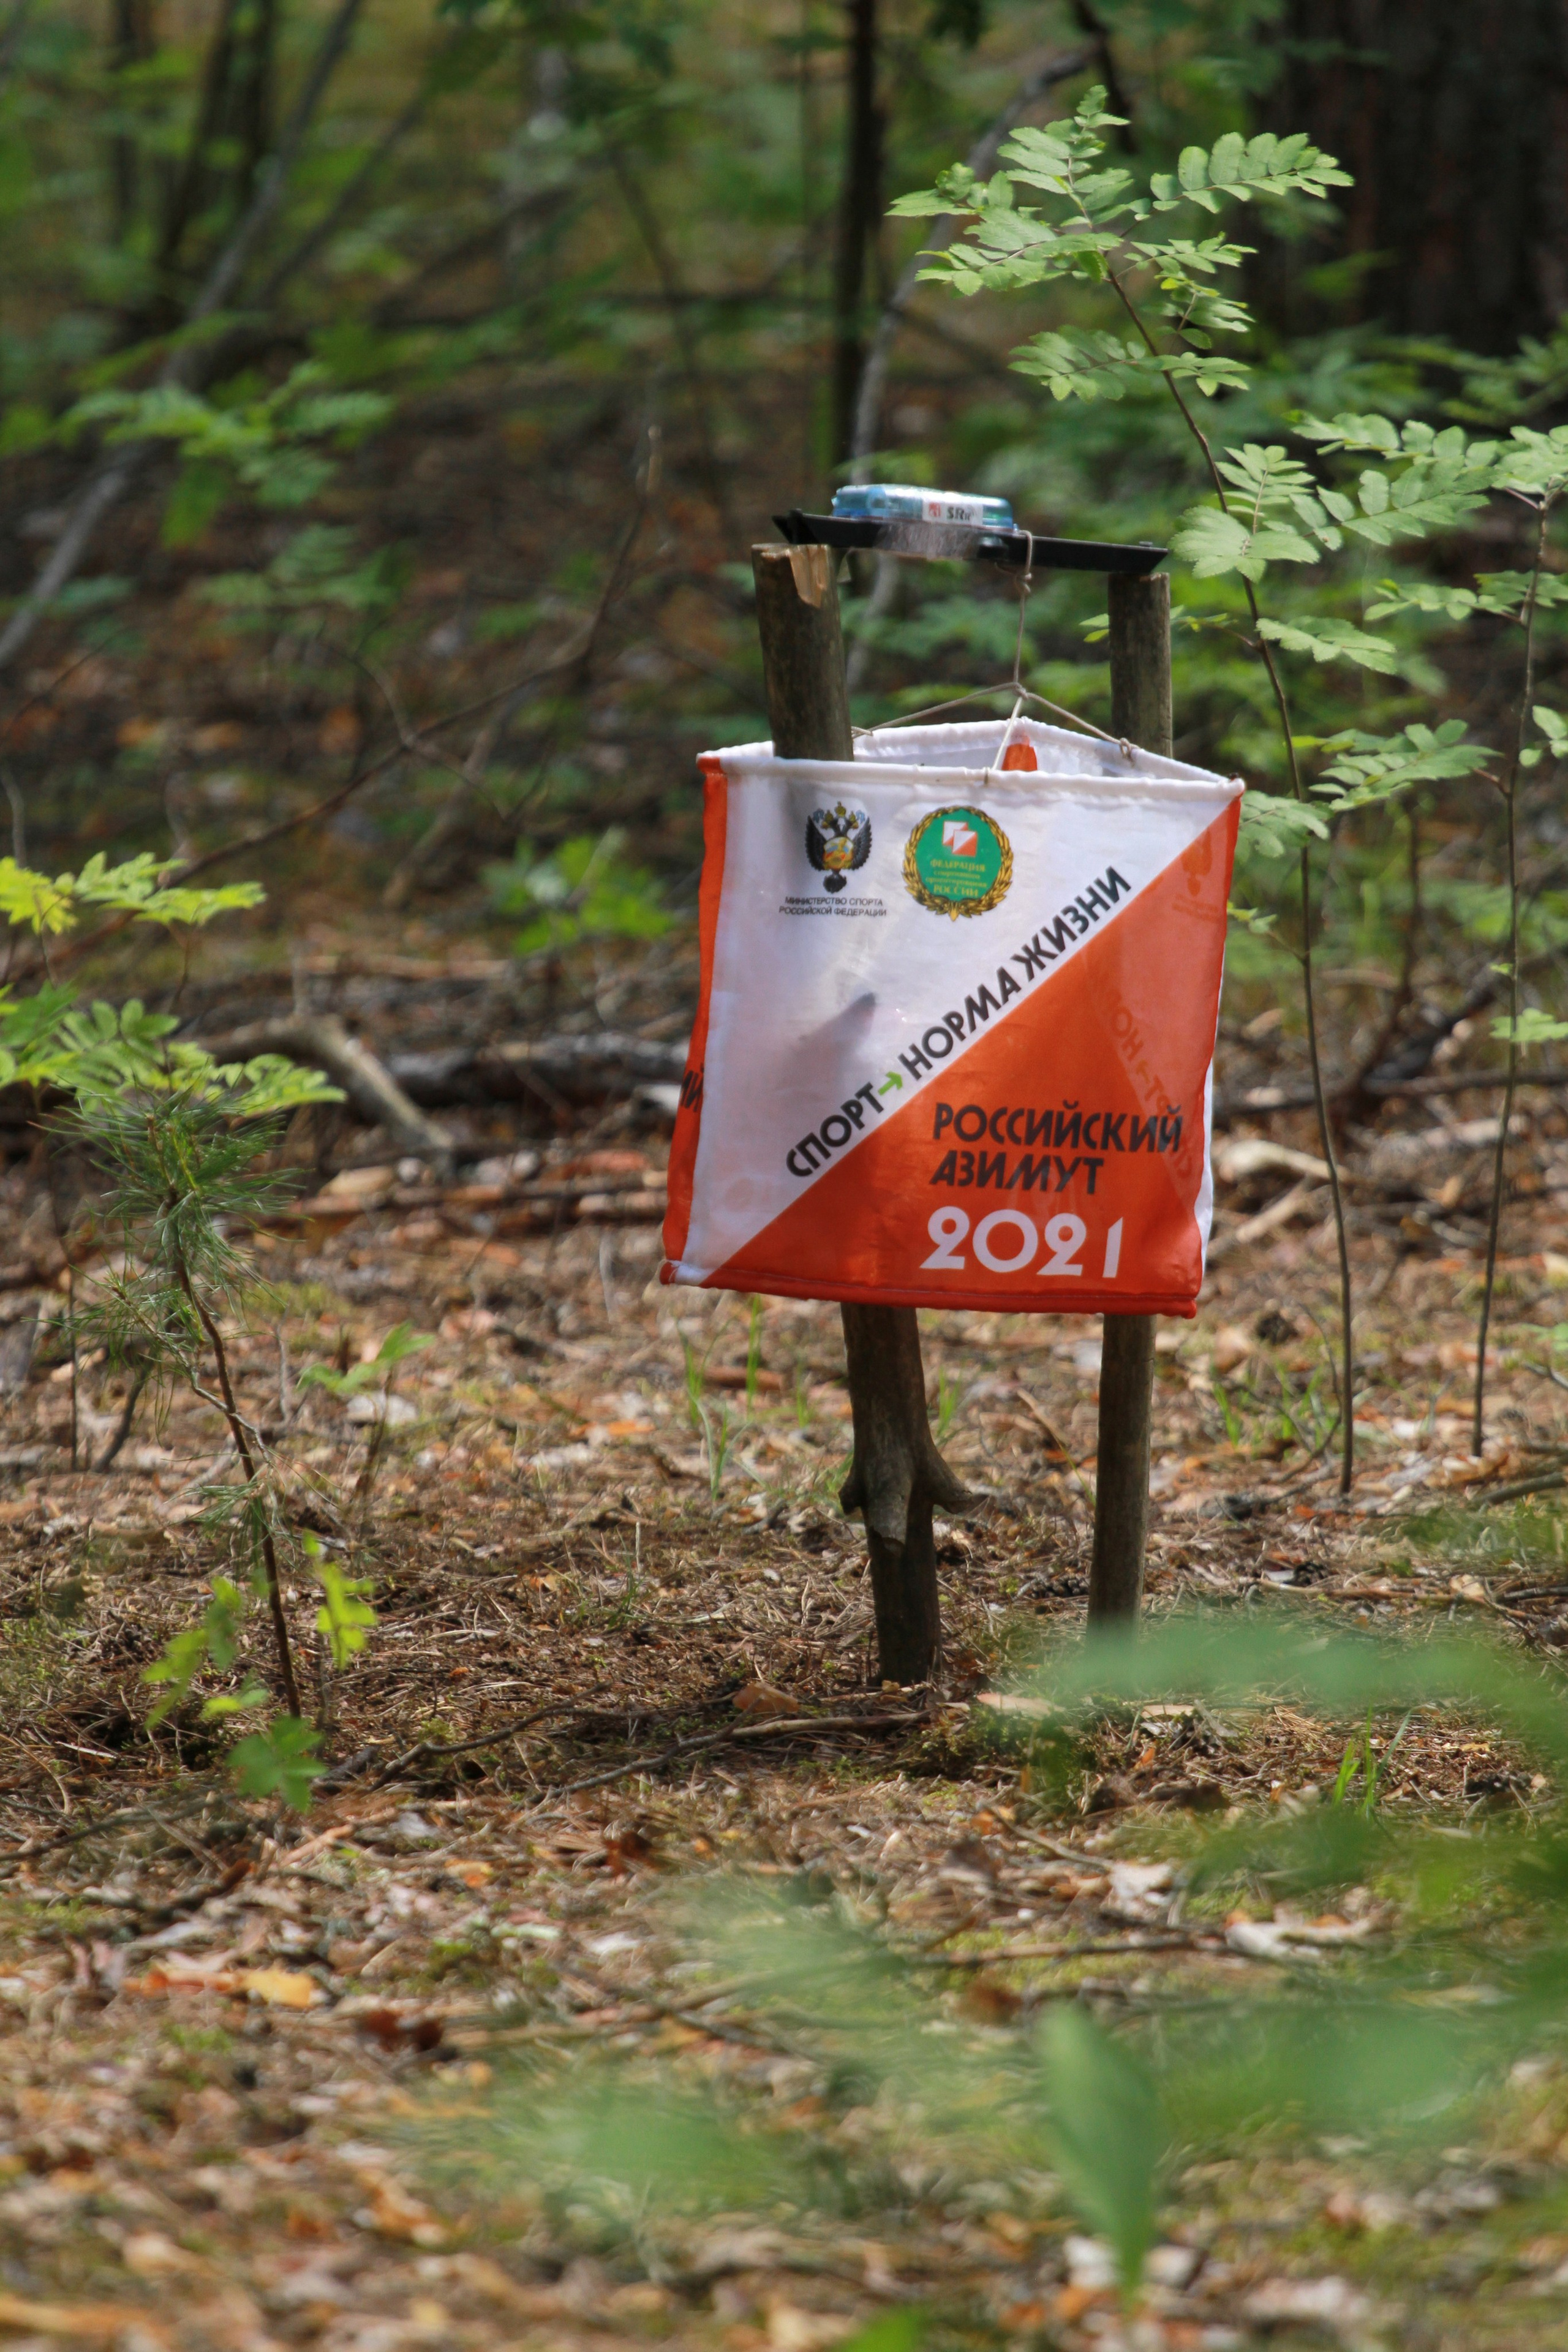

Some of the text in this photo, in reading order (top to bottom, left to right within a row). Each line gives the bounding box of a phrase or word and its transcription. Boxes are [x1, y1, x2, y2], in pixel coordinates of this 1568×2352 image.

[778, 906, 887, 918] РОССИЙСКОЙ ФЕДЕРАЦИИ
[785, 896, 846, 905] МИНИСТЕРСТВО
[786, 1082, 884, 1177] СПОРТ
[899, 967, 1021, 1080] НОРМА
[1011, 866, 1131, 980] ЖИЗНИ
[933, 1100, 1183, 1153] РОССИЙСКИЙ
[929, 1150, 1104, 1194] АЗИМУТ
[919, 1205, 1123, 1278] 2021
